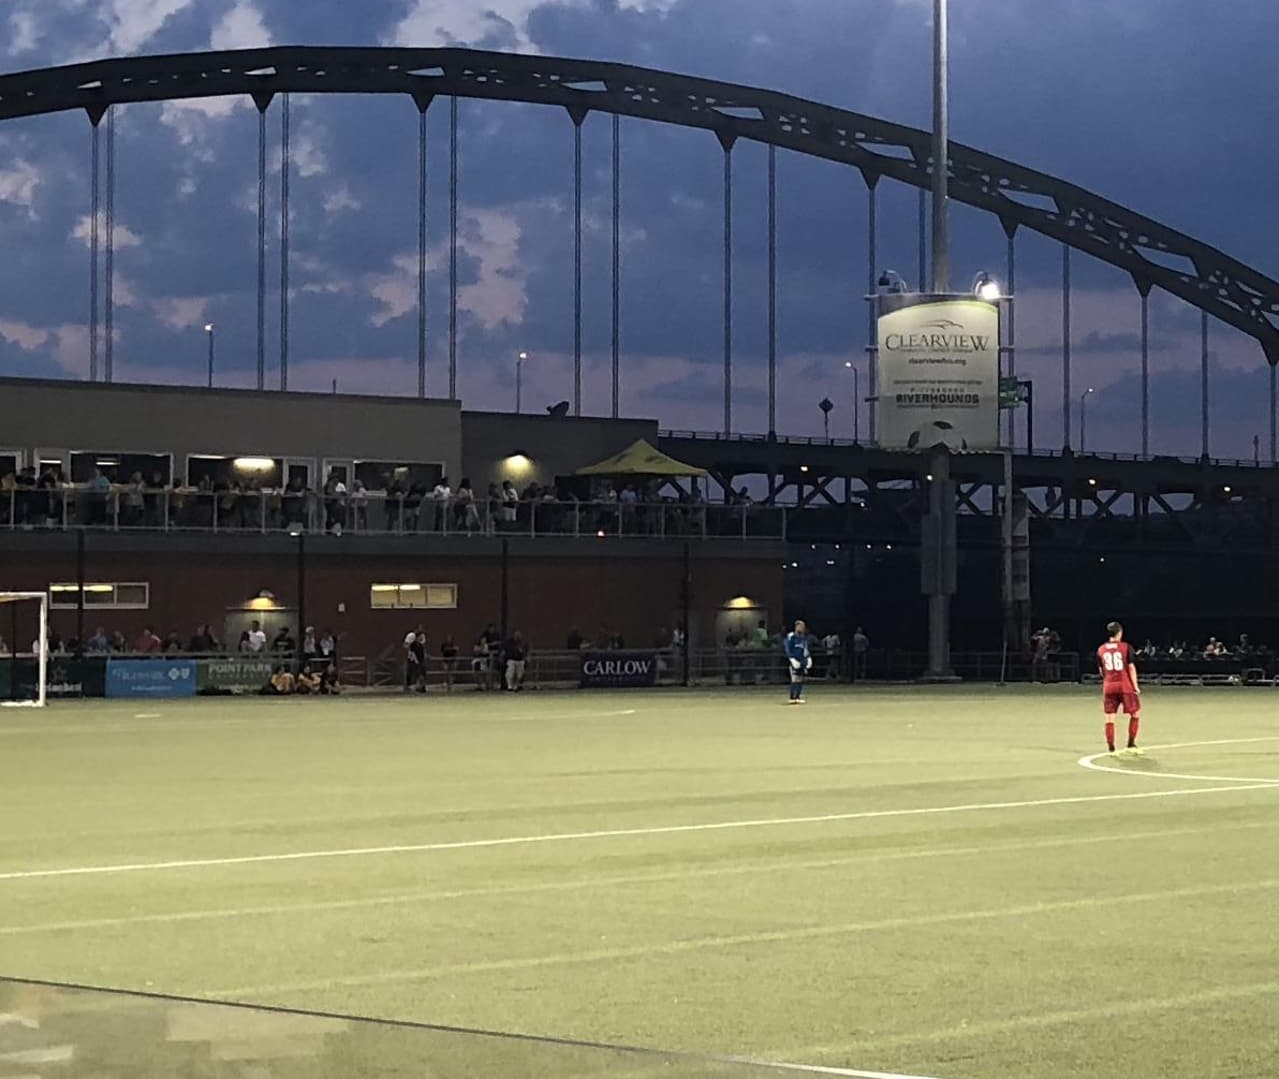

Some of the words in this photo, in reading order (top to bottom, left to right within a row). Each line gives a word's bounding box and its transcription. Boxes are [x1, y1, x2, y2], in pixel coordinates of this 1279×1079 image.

[885, 333, 991, 352] CLEARVIEW
[895, 393, 980, 404] RIVERHOUNDS
[583, 660, 652, 676] CARLOW
